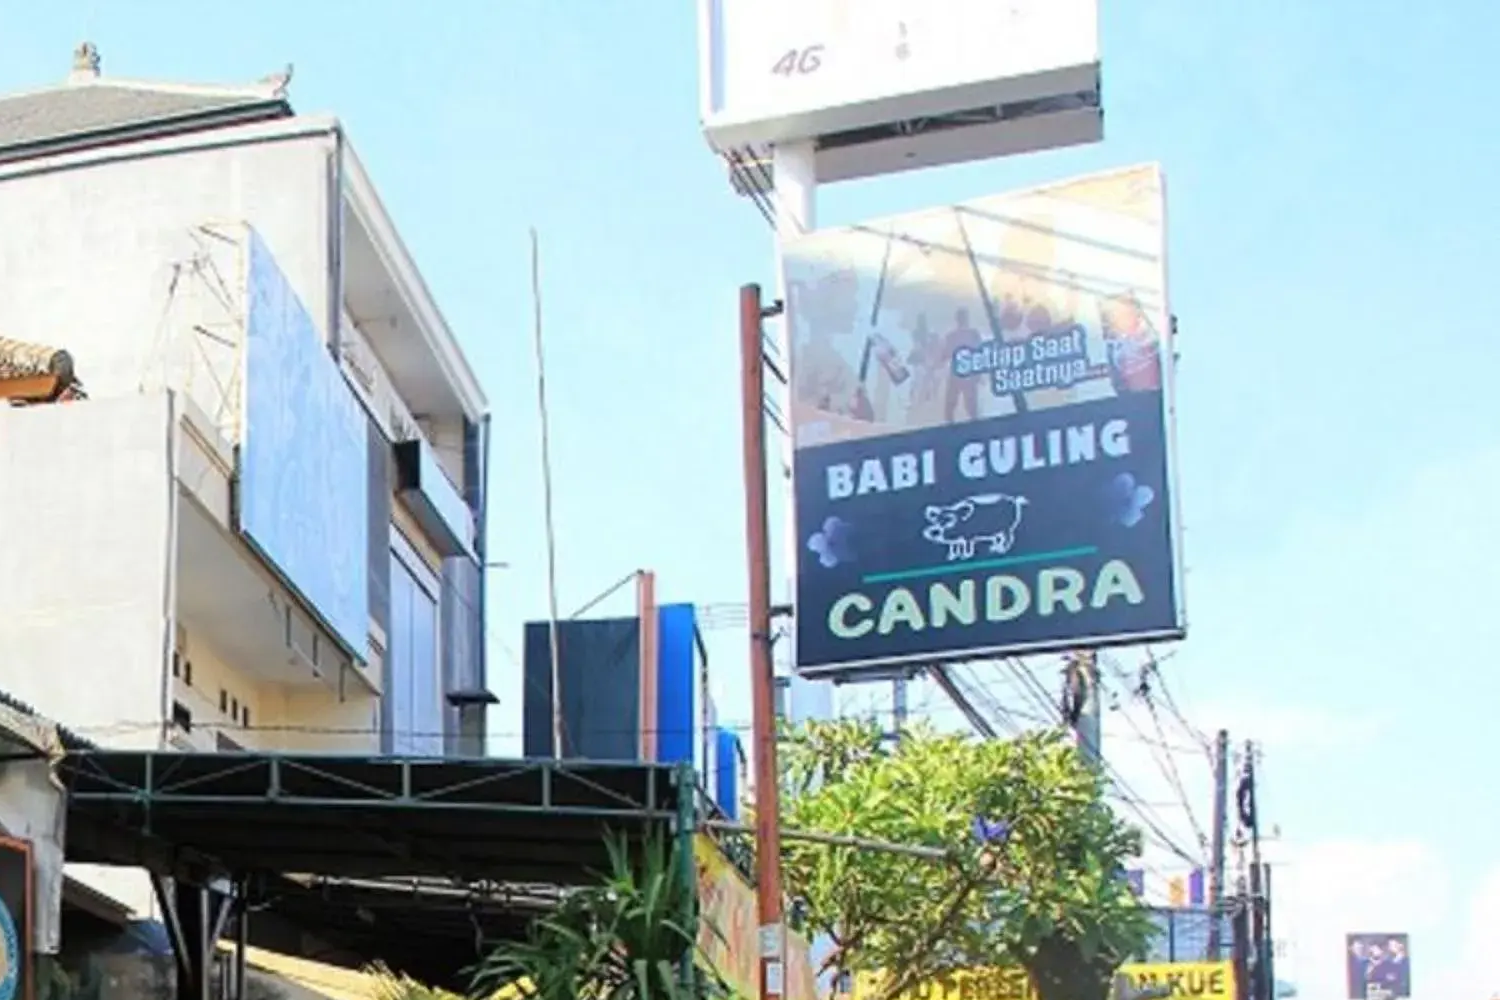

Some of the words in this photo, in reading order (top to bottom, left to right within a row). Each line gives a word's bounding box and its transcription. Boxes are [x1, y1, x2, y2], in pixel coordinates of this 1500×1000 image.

[1030, 331, 1083, 361] Saat
[826, 449, 936, 500] BABI
[958, 419, 1131, 479] GULING
[828, 559, 1144, 639] CANDRA
[1167, 969, 1225, 996] KUE
